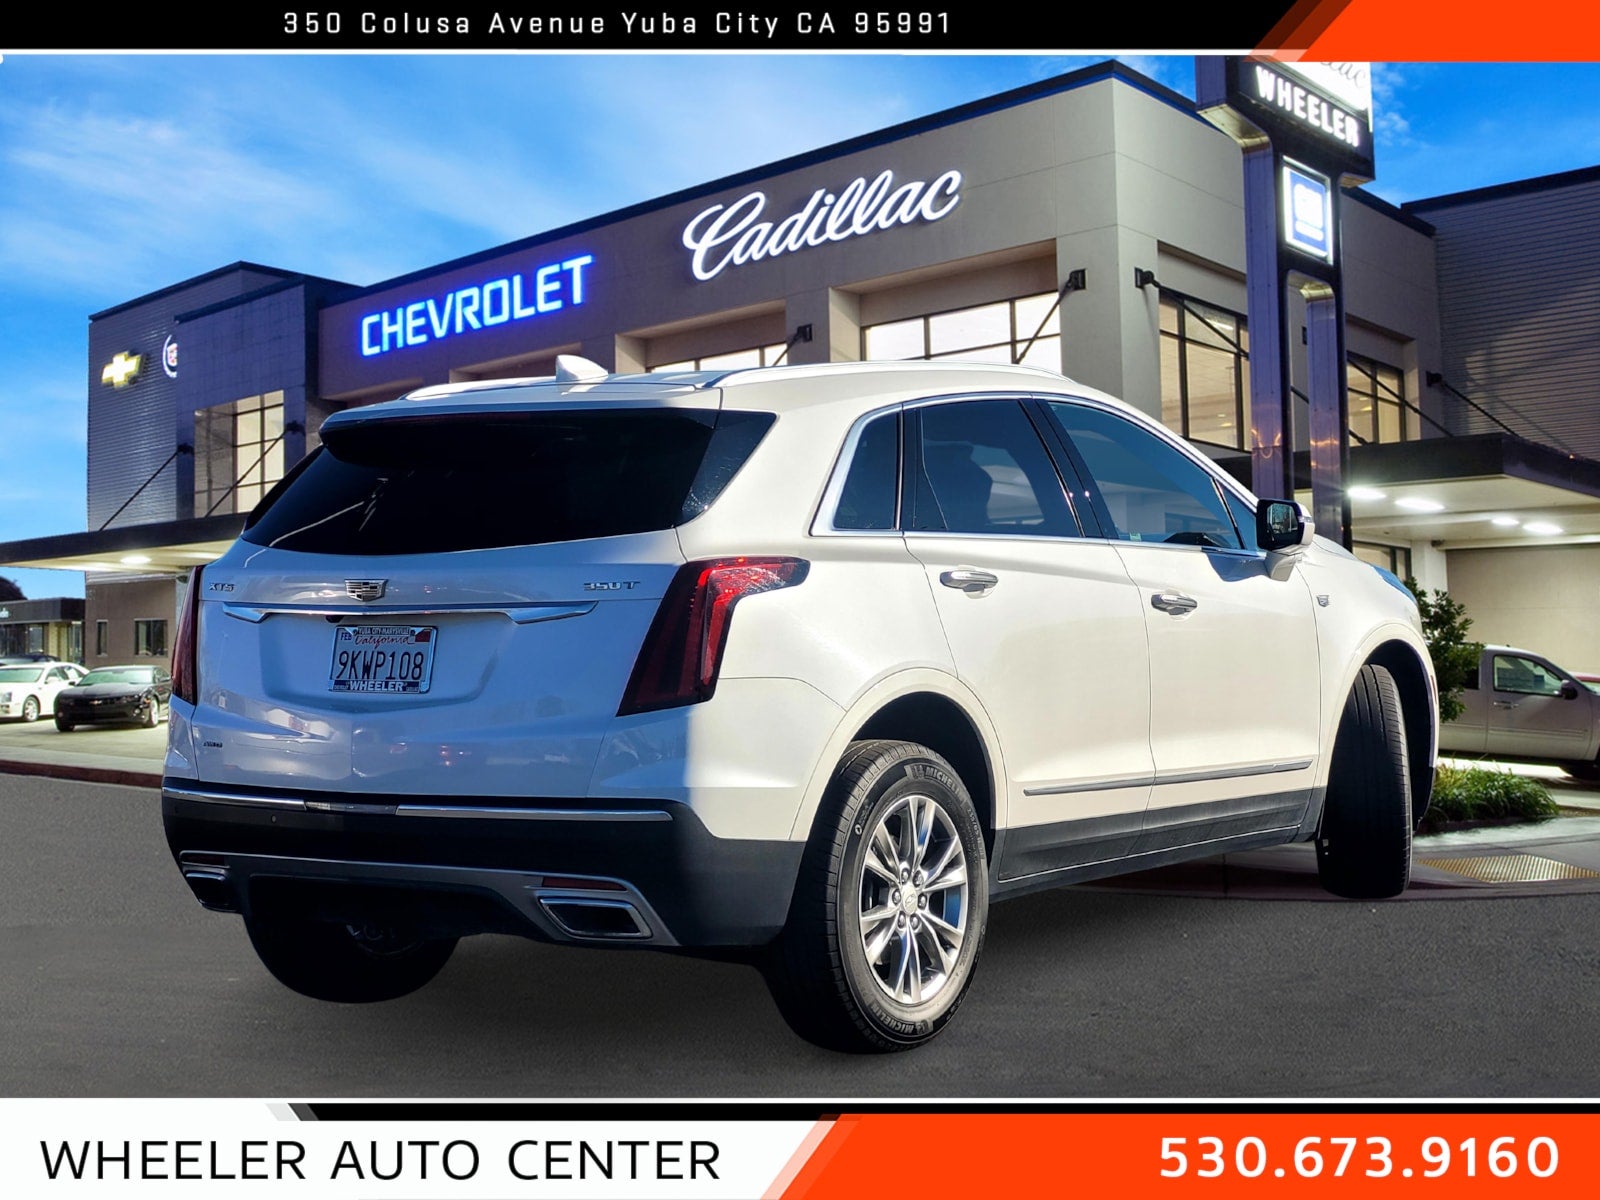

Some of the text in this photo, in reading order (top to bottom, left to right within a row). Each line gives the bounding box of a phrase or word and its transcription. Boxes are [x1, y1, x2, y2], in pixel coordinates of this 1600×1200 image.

[1255, 65, 1359, 147] WHEELER
[682, 169, 962, 281] Cadillac
[361, 254, 594, 357] CHEVROLET
[336, 650, 424, 680] 9KWP108
[355, 635, 415, 649] California
[350, 681, 404, 691] WHEELER
